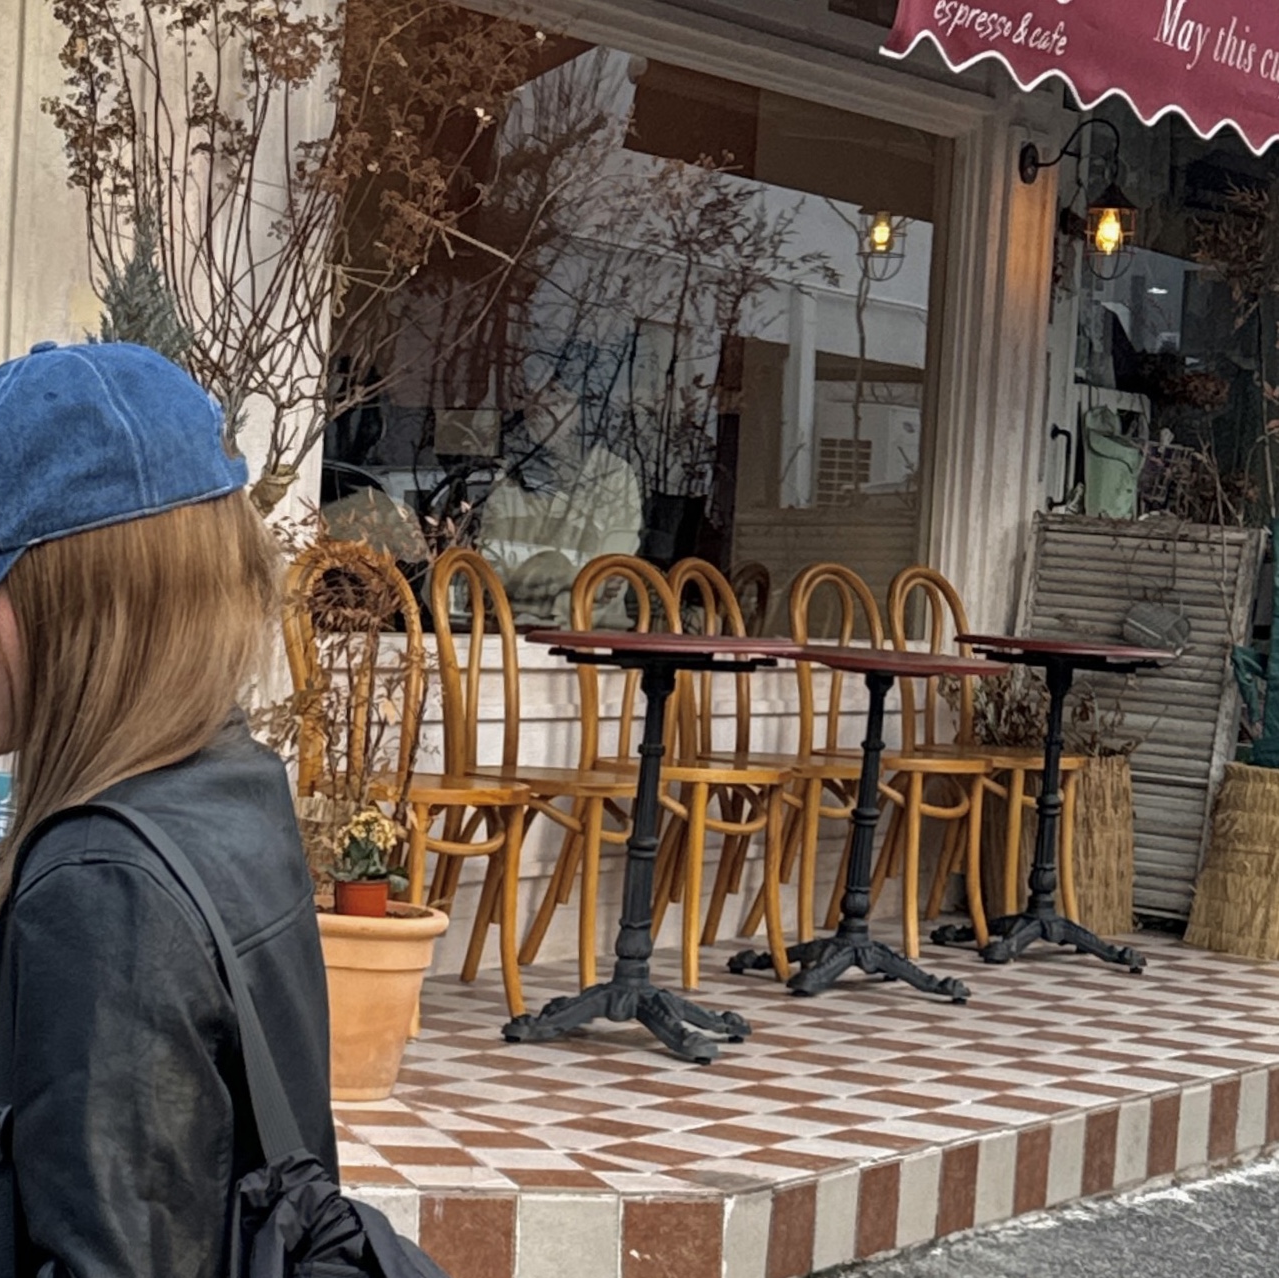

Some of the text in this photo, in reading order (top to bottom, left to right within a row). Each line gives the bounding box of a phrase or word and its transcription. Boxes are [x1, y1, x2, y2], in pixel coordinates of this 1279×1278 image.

[933, 0, 1012, 41] espresso
[1028, 21, 1067, 55] cafe
[1153, 0, 1211, 70] May
[1213, 16, 1257, 73] this
